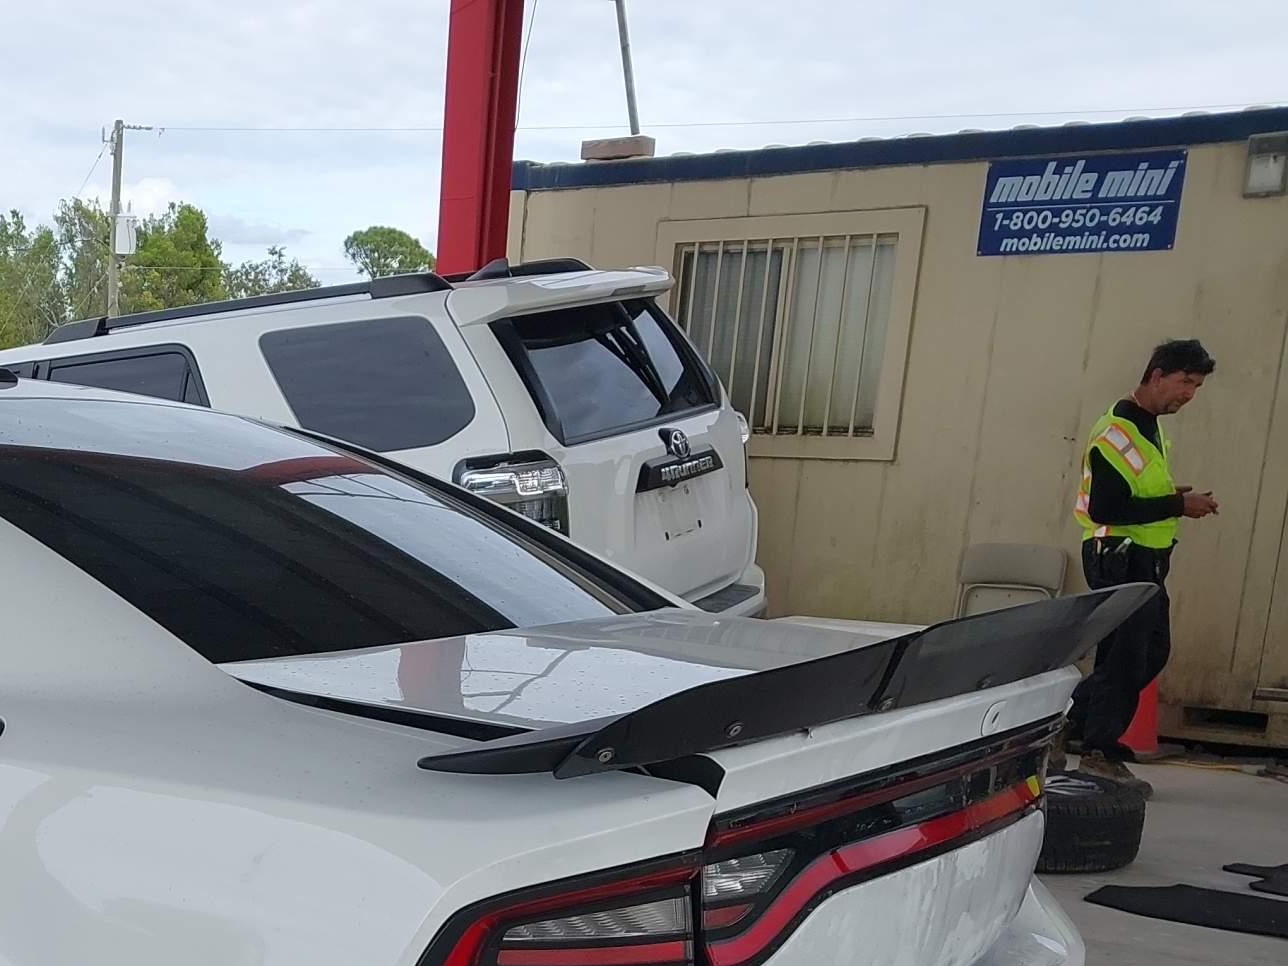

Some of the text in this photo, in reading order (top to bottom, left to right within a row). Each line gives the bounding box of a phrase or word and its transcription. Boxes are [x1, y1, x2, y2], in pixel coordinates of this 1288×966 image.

[989, 159, 1179, 203] mobile mini
[994, 206, 1162, 231] 1-800-950-6464
[999, 230, 1150, 252] mobilemini.com
